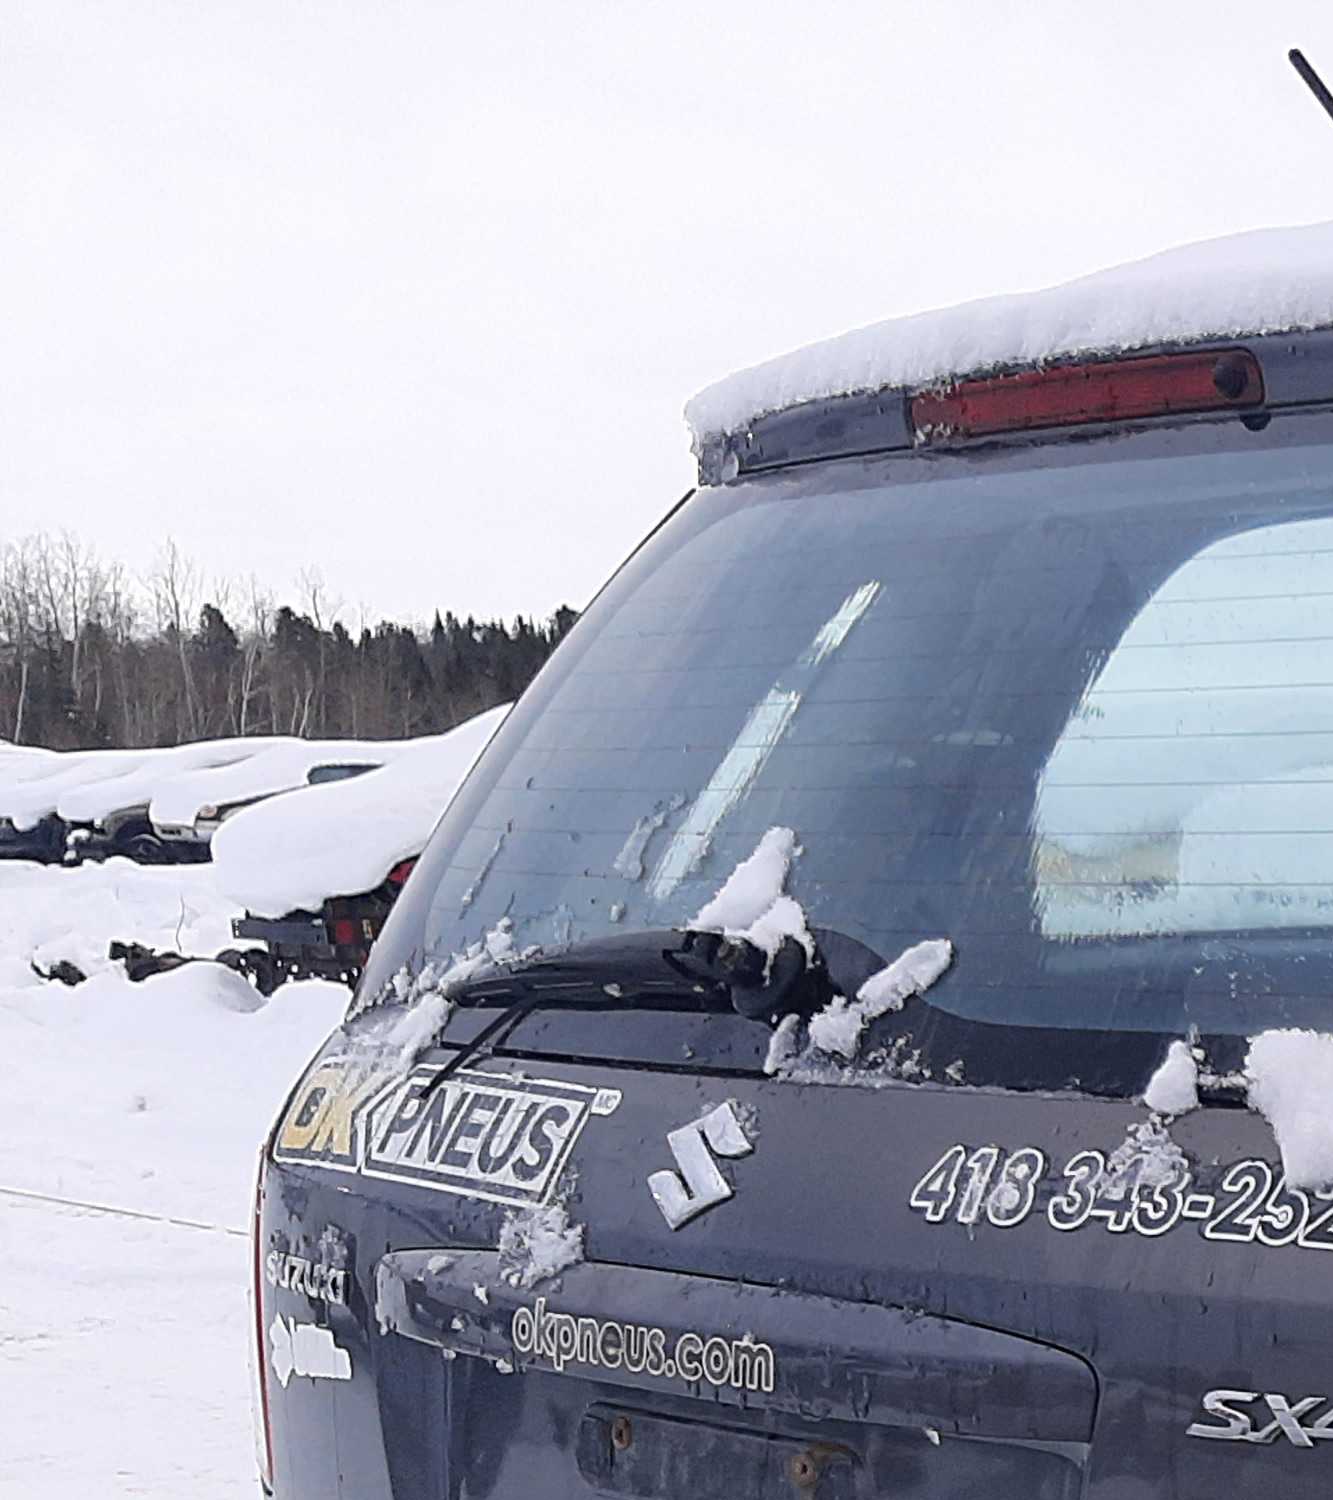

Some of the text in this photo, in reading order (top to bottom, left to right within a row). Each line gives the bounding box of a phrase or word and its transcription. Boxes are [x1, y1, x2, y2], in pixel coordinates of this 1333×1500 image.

[375, 1082, 571, 1182] PNEUS
[910, 1144, 1045, 1227] 418
[512, 1297, 775, 1392] okpneus.com
